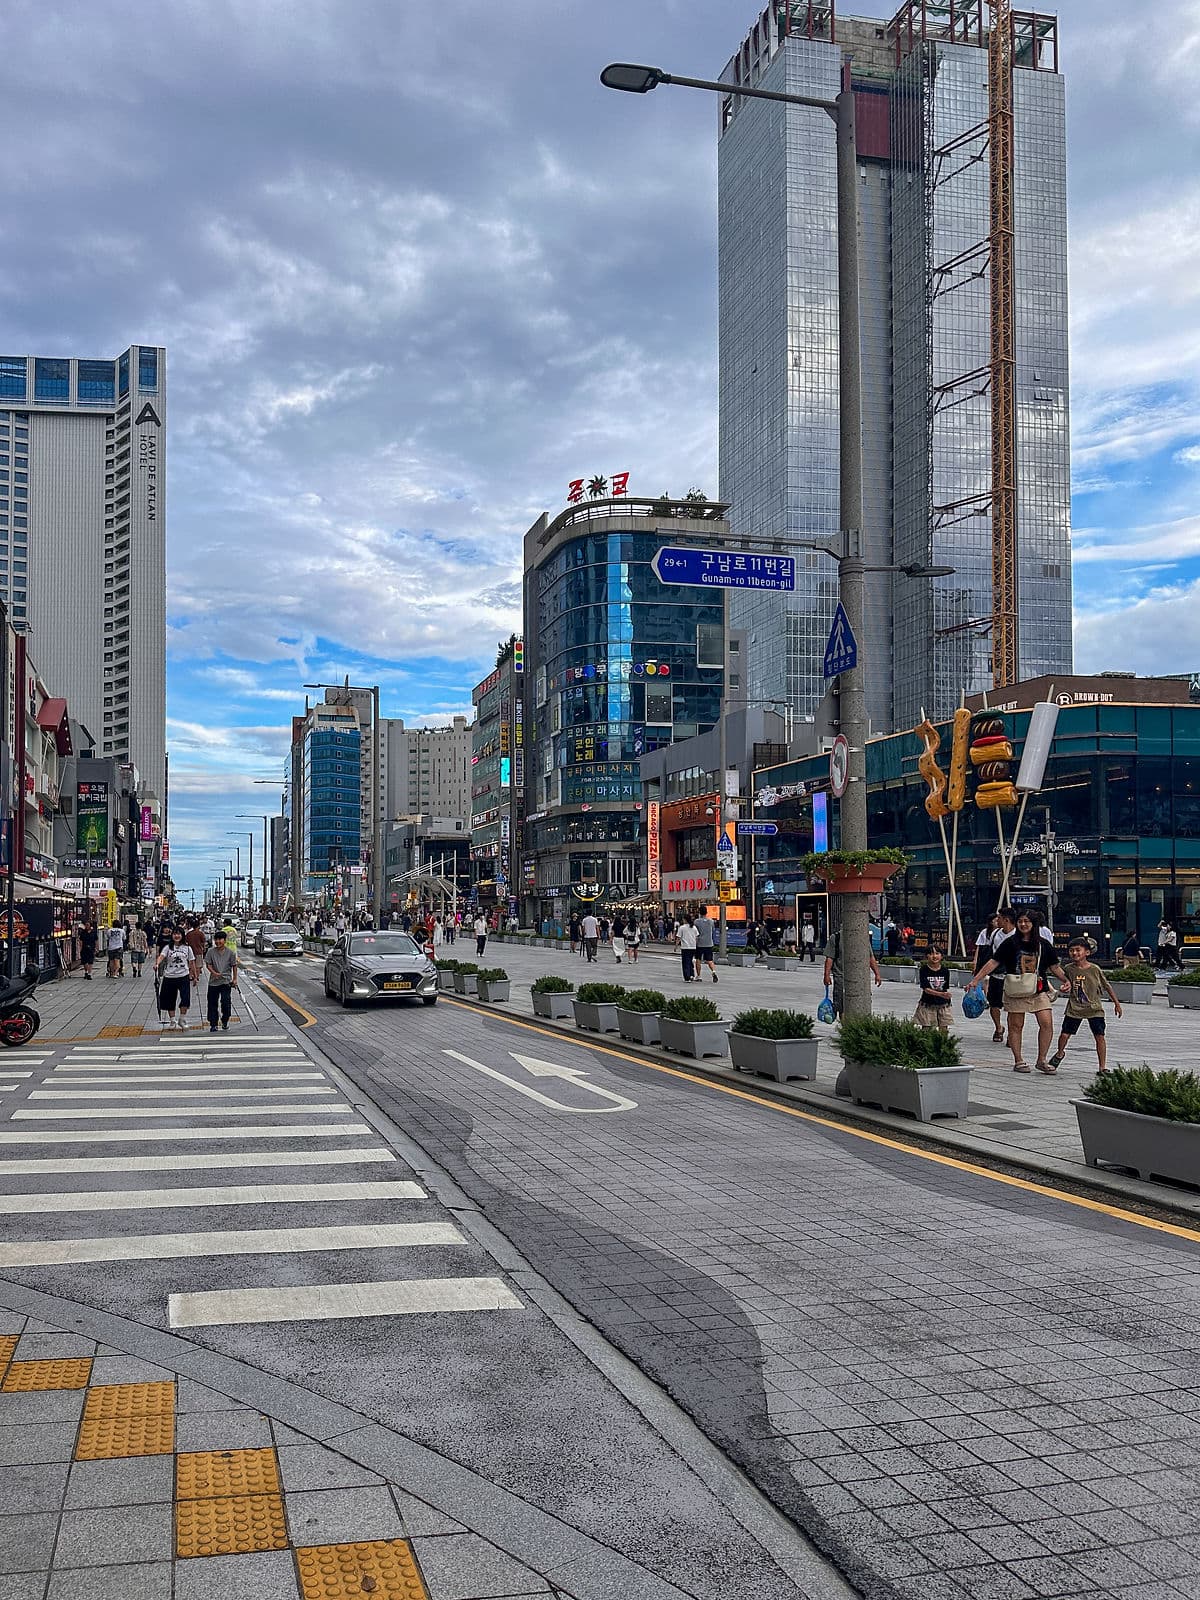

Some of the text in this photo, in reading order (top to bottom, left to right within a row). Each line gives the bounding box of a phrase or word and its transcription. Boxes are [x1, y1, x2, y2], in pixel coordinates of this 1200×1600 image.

[140, 435, 148, 470] HOTEL
[147, 436, 156, 521] LAVI DE ATLAN
[701, 573, 792, 589] Gunam-ro 11beon-gil
[575, 738, 594, 749] 코인
[575, 750, 594, 762] 노래
[649, 832, 657, 860] PIZZA
